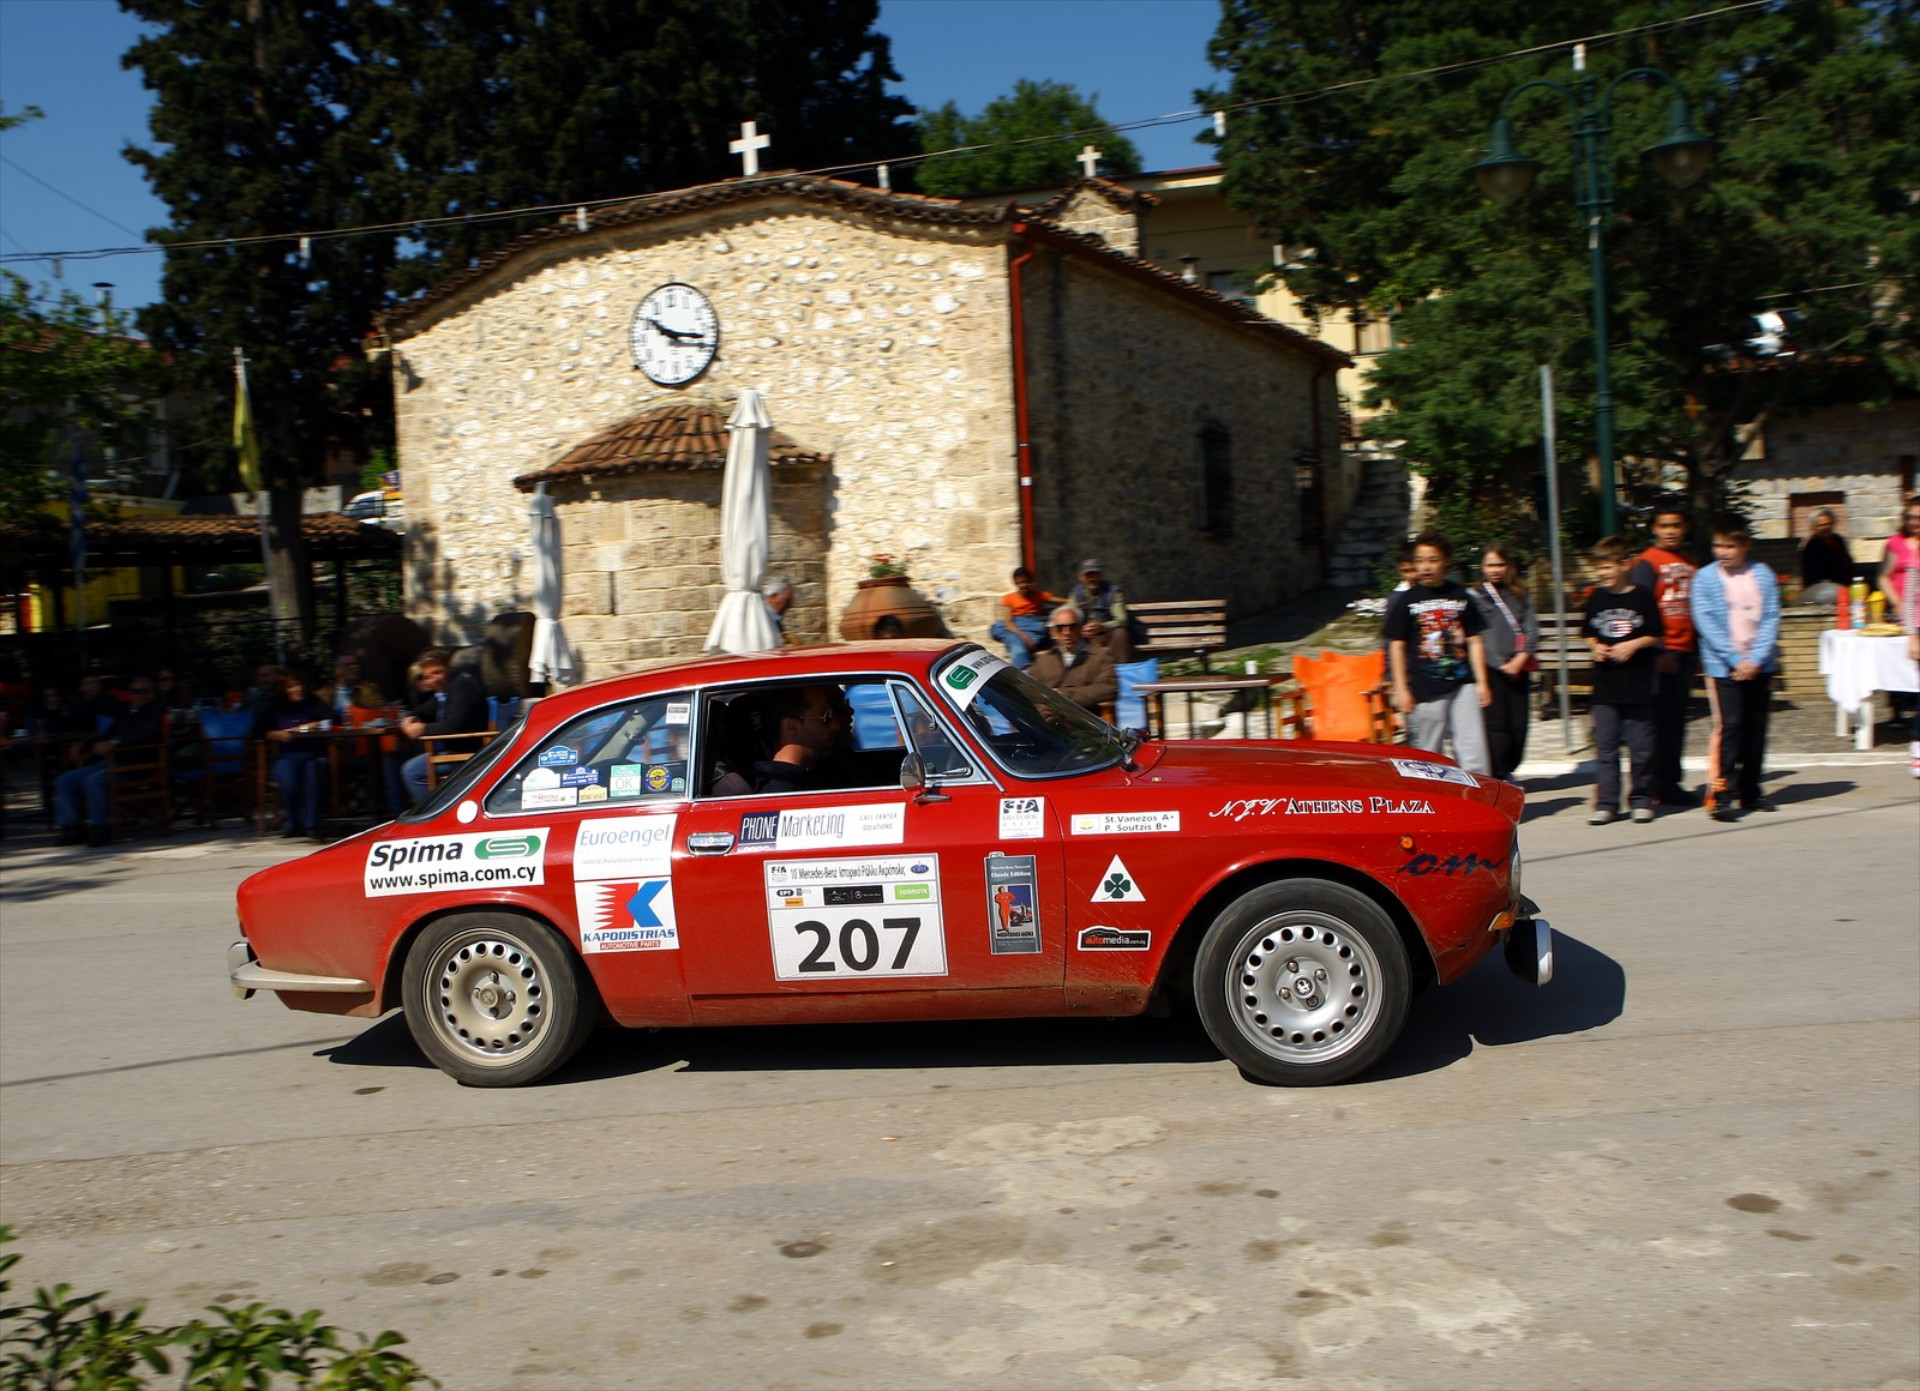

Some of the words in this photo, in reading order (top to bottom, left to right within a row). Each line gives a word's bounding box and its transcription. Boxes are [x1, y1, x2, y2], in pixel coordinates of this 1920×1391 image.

[615, 778, 633, 789] OK
[875, 812, 897, 820] CENTER
[741, 815, 778, 841] PHONE
[781, 812, 845, 838] Marketing
[862, 823, 893, 831] SOLUTIONS
[1104, 824, 1113, 832] P.
[1117, 822, 1152, 832] Soutzis
[580, 824, 670, 847] Euroengel
[370, 840, 463, 872] Spima
[369, 864, 536, 890] www.spima.com.cy
[583, 928, 675, 942] KAPODISTRIAS
[600, 941, 639, 950] AUTOMOTIVE
[640, 940, 660, 949] PARTS
[795, 917, 921, 973] 207
